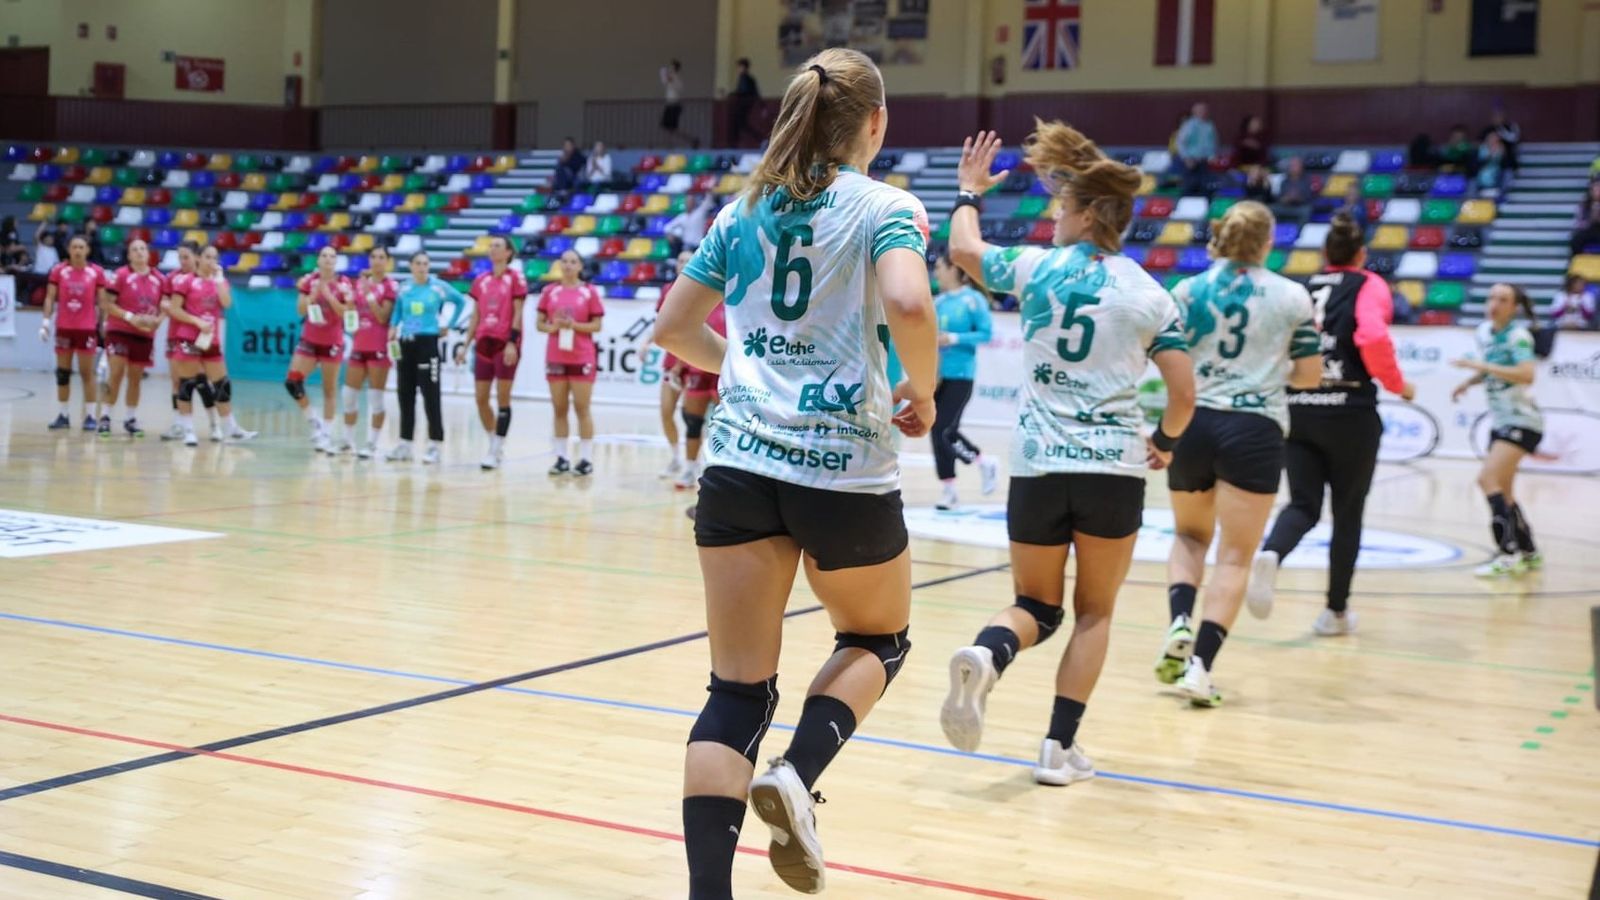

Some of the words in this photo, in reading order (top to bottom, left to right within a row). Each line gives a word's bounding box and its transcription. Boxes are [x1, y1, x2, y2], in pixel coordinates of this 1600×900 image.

[771, 224, 813, 321] 6
[242, 323, 303, 355] atti
[769, 335, 815, 356] elche
[1057, 292, 1101, 362] 5
[1218, 303, 1249, 359] 3
[736, 434, 853, 471] urbaser
[1044, 443, 1124, 461] urbaser
